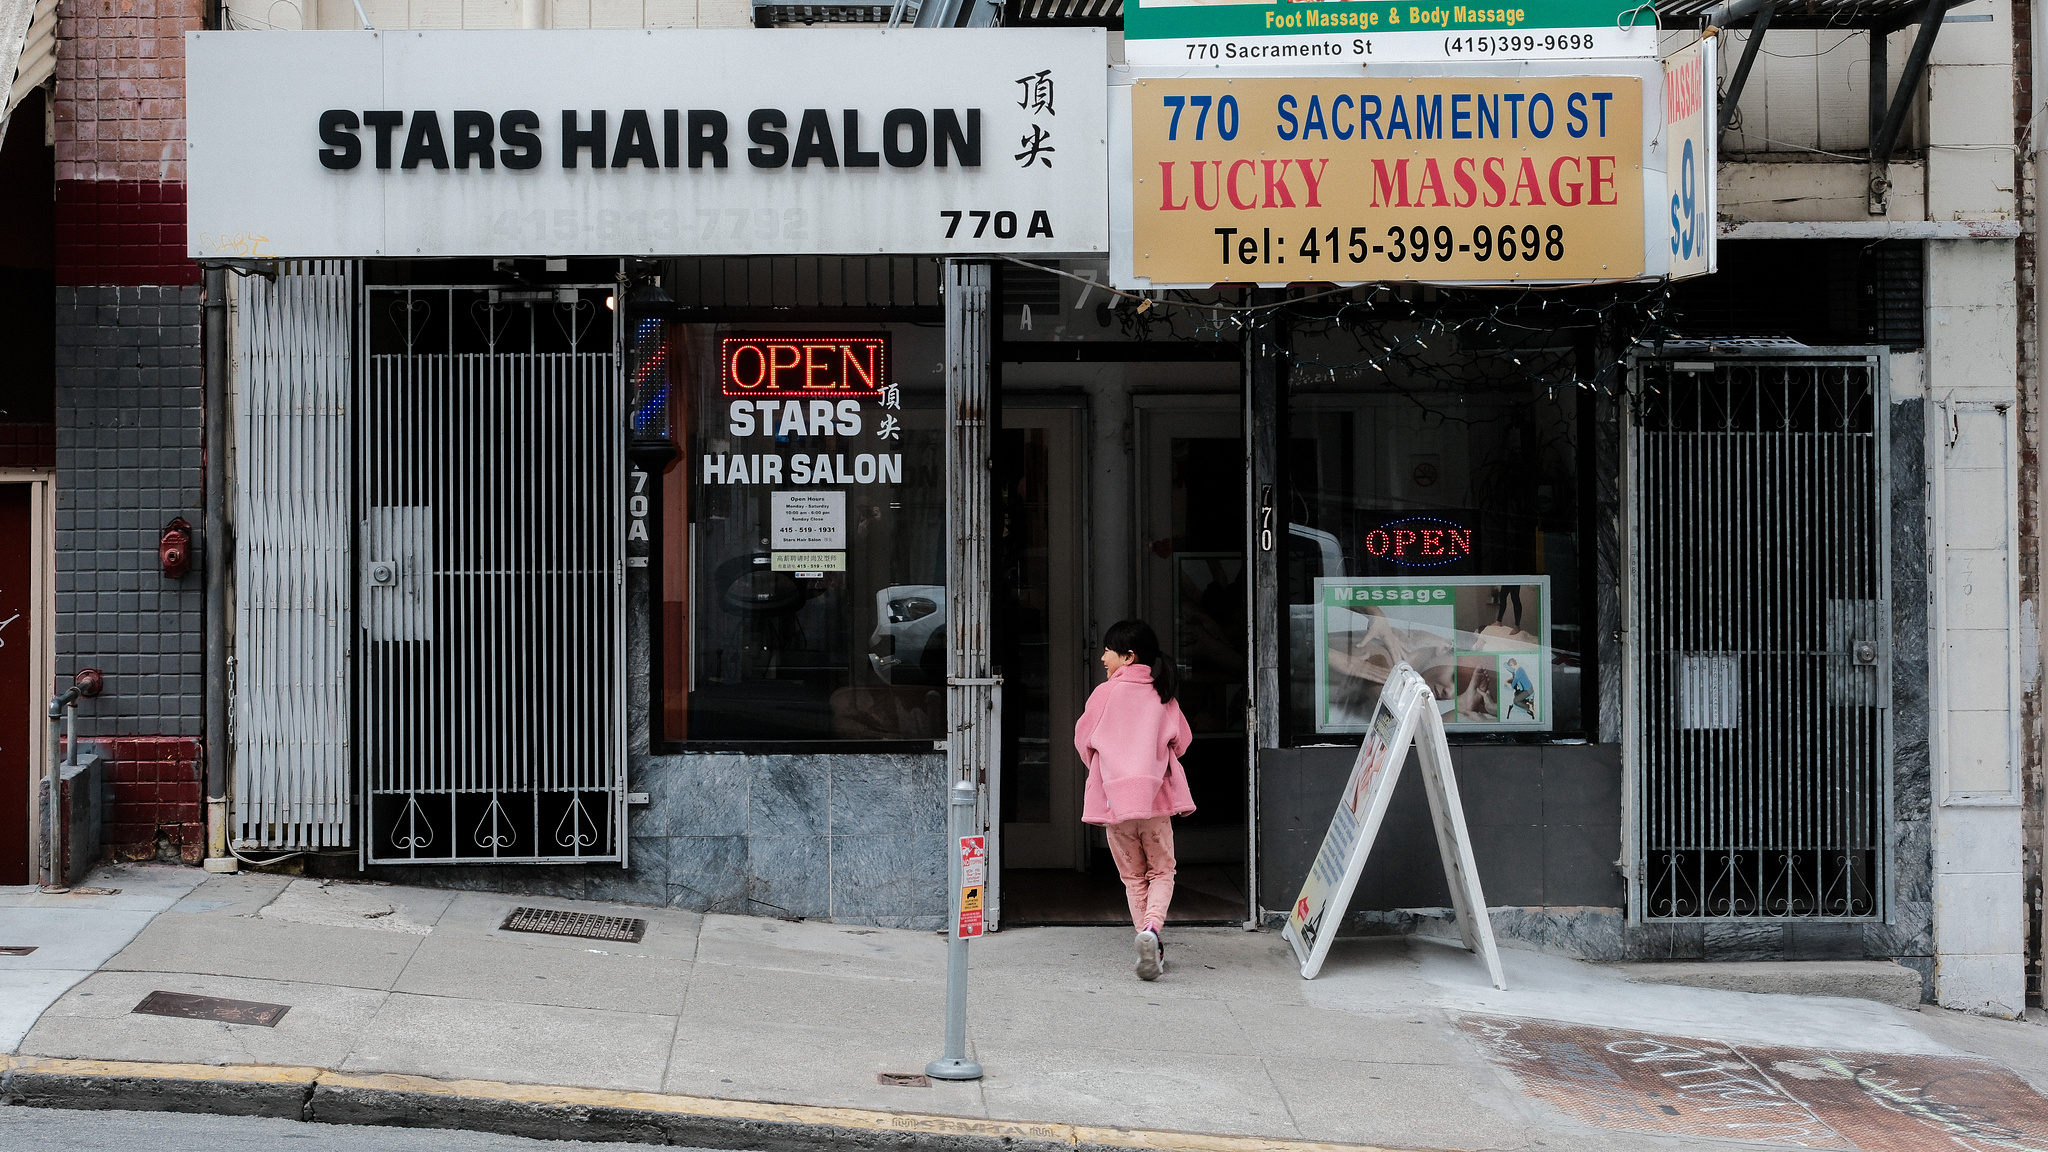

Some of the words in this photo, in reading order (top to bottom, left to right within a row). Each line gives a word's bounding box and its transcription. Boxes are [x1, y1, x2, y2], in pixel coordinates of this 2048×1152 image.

[1266, 11, 1302, 28] Foot
[1307, 10, 1379, 29] Massage
[1389, 7, 1400, 24] &
[1409, 7, 1449, 27] Body
[1454, 6, 1525, 25] Massage
[1186, 44, 1219, 59] 770
[1225, 41, 1342, 58] Sacramento
[1353, 39, 1373, 54] St
[1444, 34, 1595, 56] (415)399-9698
[1667, 54, 1702, 124] MASSAGE
[1015, 69, 1056, 169] 頂尖
[1163, 95, 1239, 141] 770
[1276, 92, 1555, 140] SACRAMENTO
[1566, 92, 1613, 138] ST
[318, 109, 542, 169] STARS
[561, 109, 729, 168] HAIR
[747, 108, 982, 168] SALON
[1159, 158, 1330, 211] LUCKY
[1369, 155, 1618, 209] MASSAGE
[940, 210, 1018, 239] 770
[1026, 210, 1055, 239] A
[1214, 227, 1285, 264] Tel:
[1299, 224, 1565, 264] 415-399-9698
[1020, 304, 1033, 331] A
[731, 344, 878, 390] OPEN
[729, 400, 862, 437] STARS
[876, 382, 901, 440] 頂尖
[703, 454, 783, 485] HAIR
[790, 453, 902, 485] SALON
[627, 464, 650, 542] 70A
[1261, 484, 1272, 551] 770
[1366, 529, 1472, 556] OPEN
[1334, 587, 1447, 602] Massage
